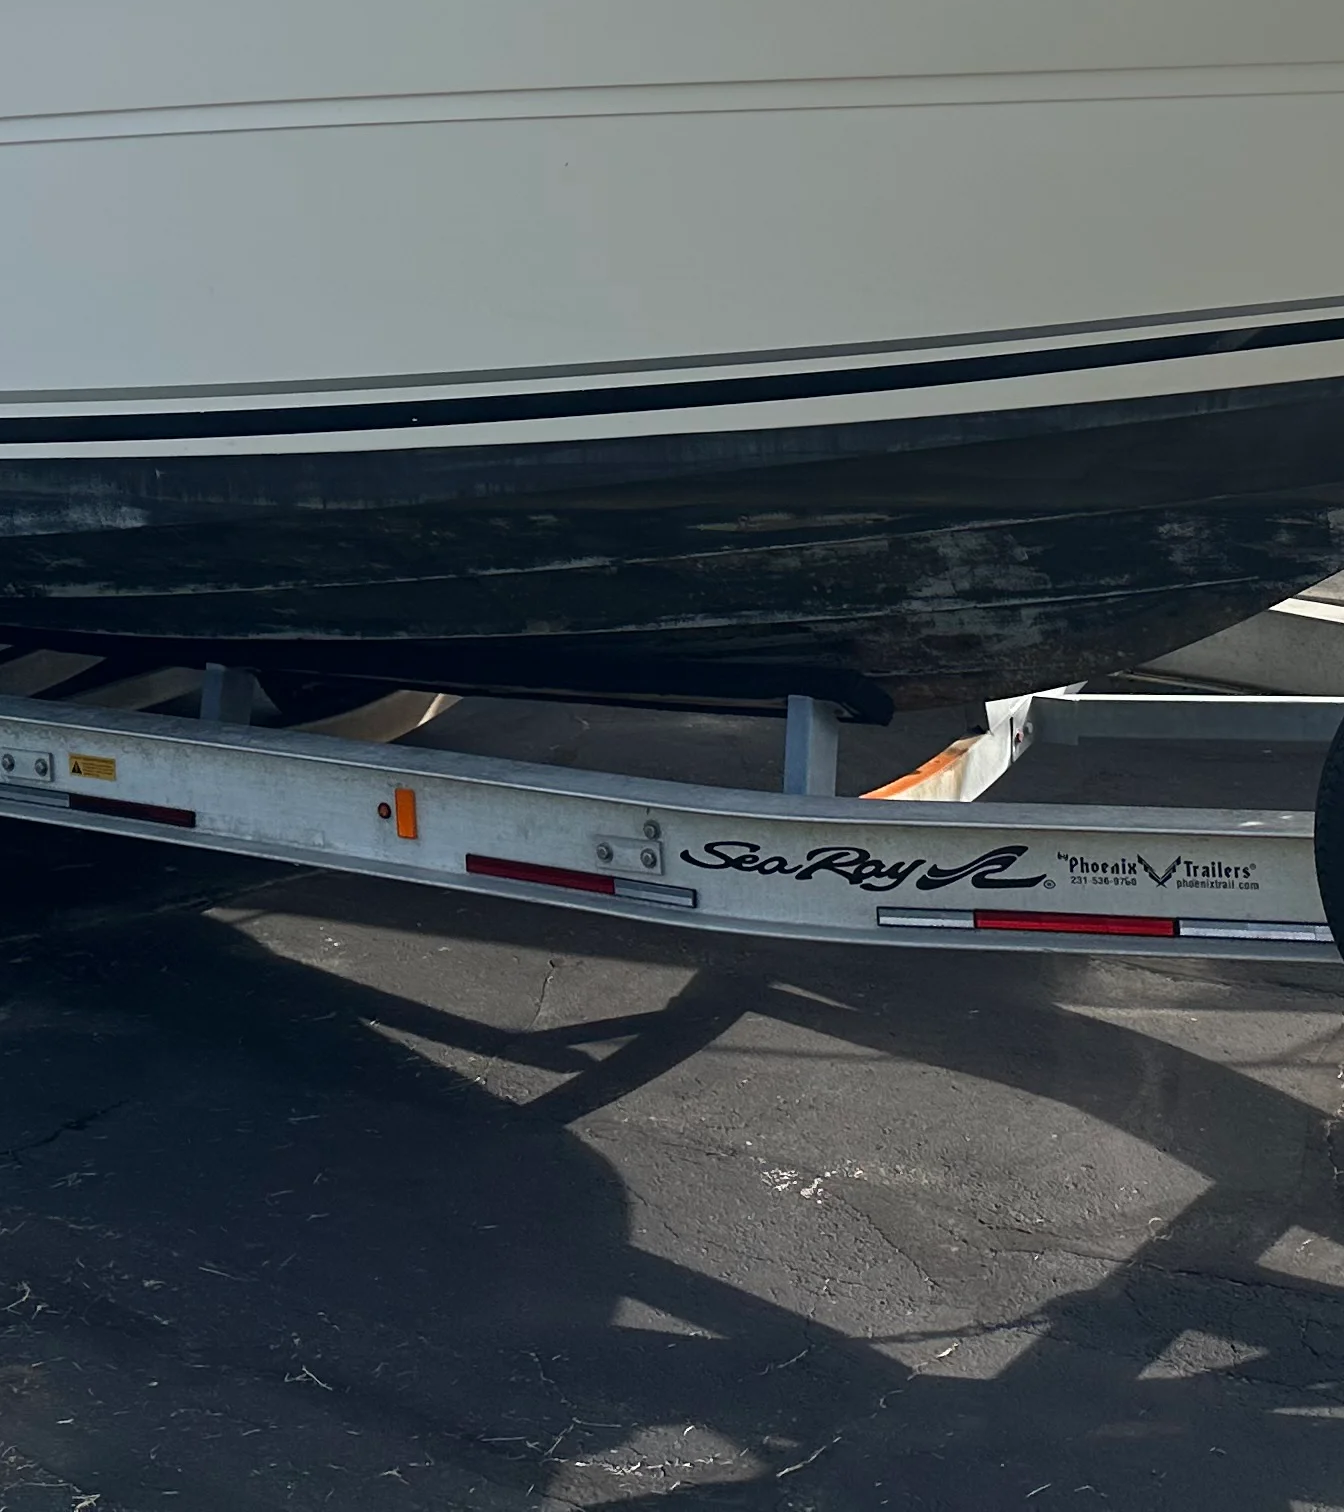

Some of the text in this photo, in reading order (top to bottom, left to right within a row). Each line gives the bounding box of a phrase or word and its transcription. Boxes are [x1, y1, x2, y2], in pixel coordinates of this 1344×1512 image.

[679, 841, 926, 891] Sea Ray
[1069, 856, 1137, 875] Phoenix
